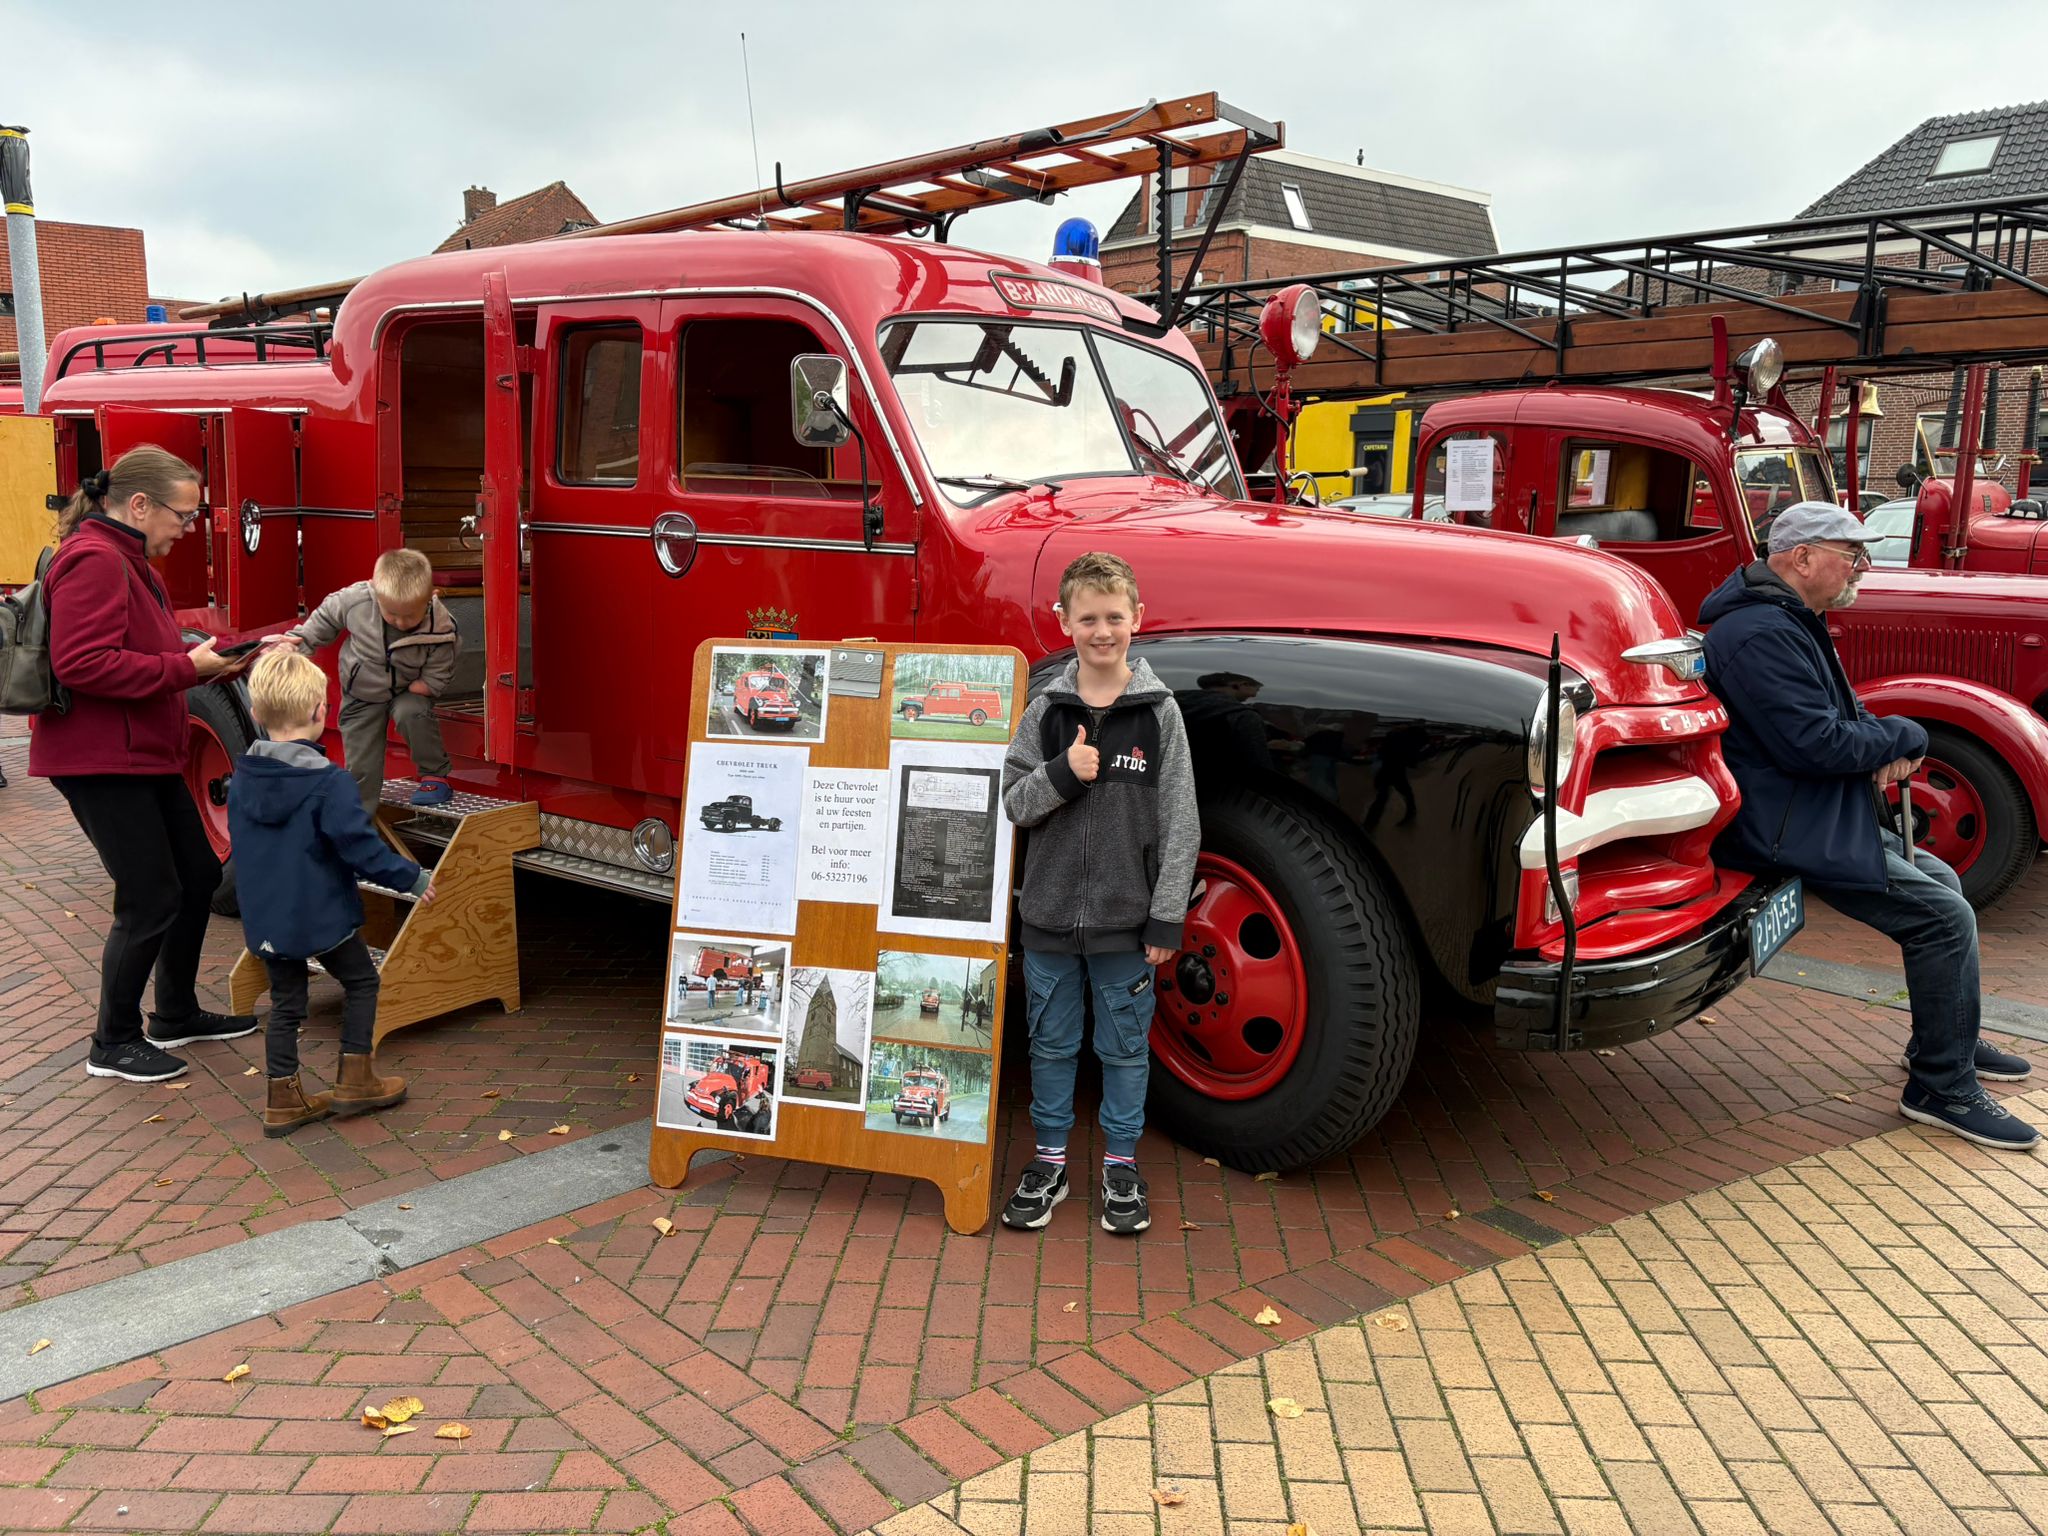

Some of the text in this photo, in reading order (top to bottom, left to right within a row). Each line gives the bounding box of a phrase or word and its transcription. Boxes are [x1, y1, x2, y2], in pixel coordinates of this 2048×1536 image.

[1001, 280, 1118, 319] BRANDWEER
[716, 760, 755, 768] CHEVROLET
[812, 779, 879, 792] Deze Chevrolet
[814, 793, 876, 805] is te huur voor
[815, 806, 825, 816] al
[841, 807, 872, 818] feesten
[819, 821, 867, 833] en partijen.
[811, 845, 872, 857] Bel voor meer
[830, 859, 851, 870] info:
[811, 871, 868, 883] 06-53237196
[1756, 888, 1797, 959] PJ-21-55
